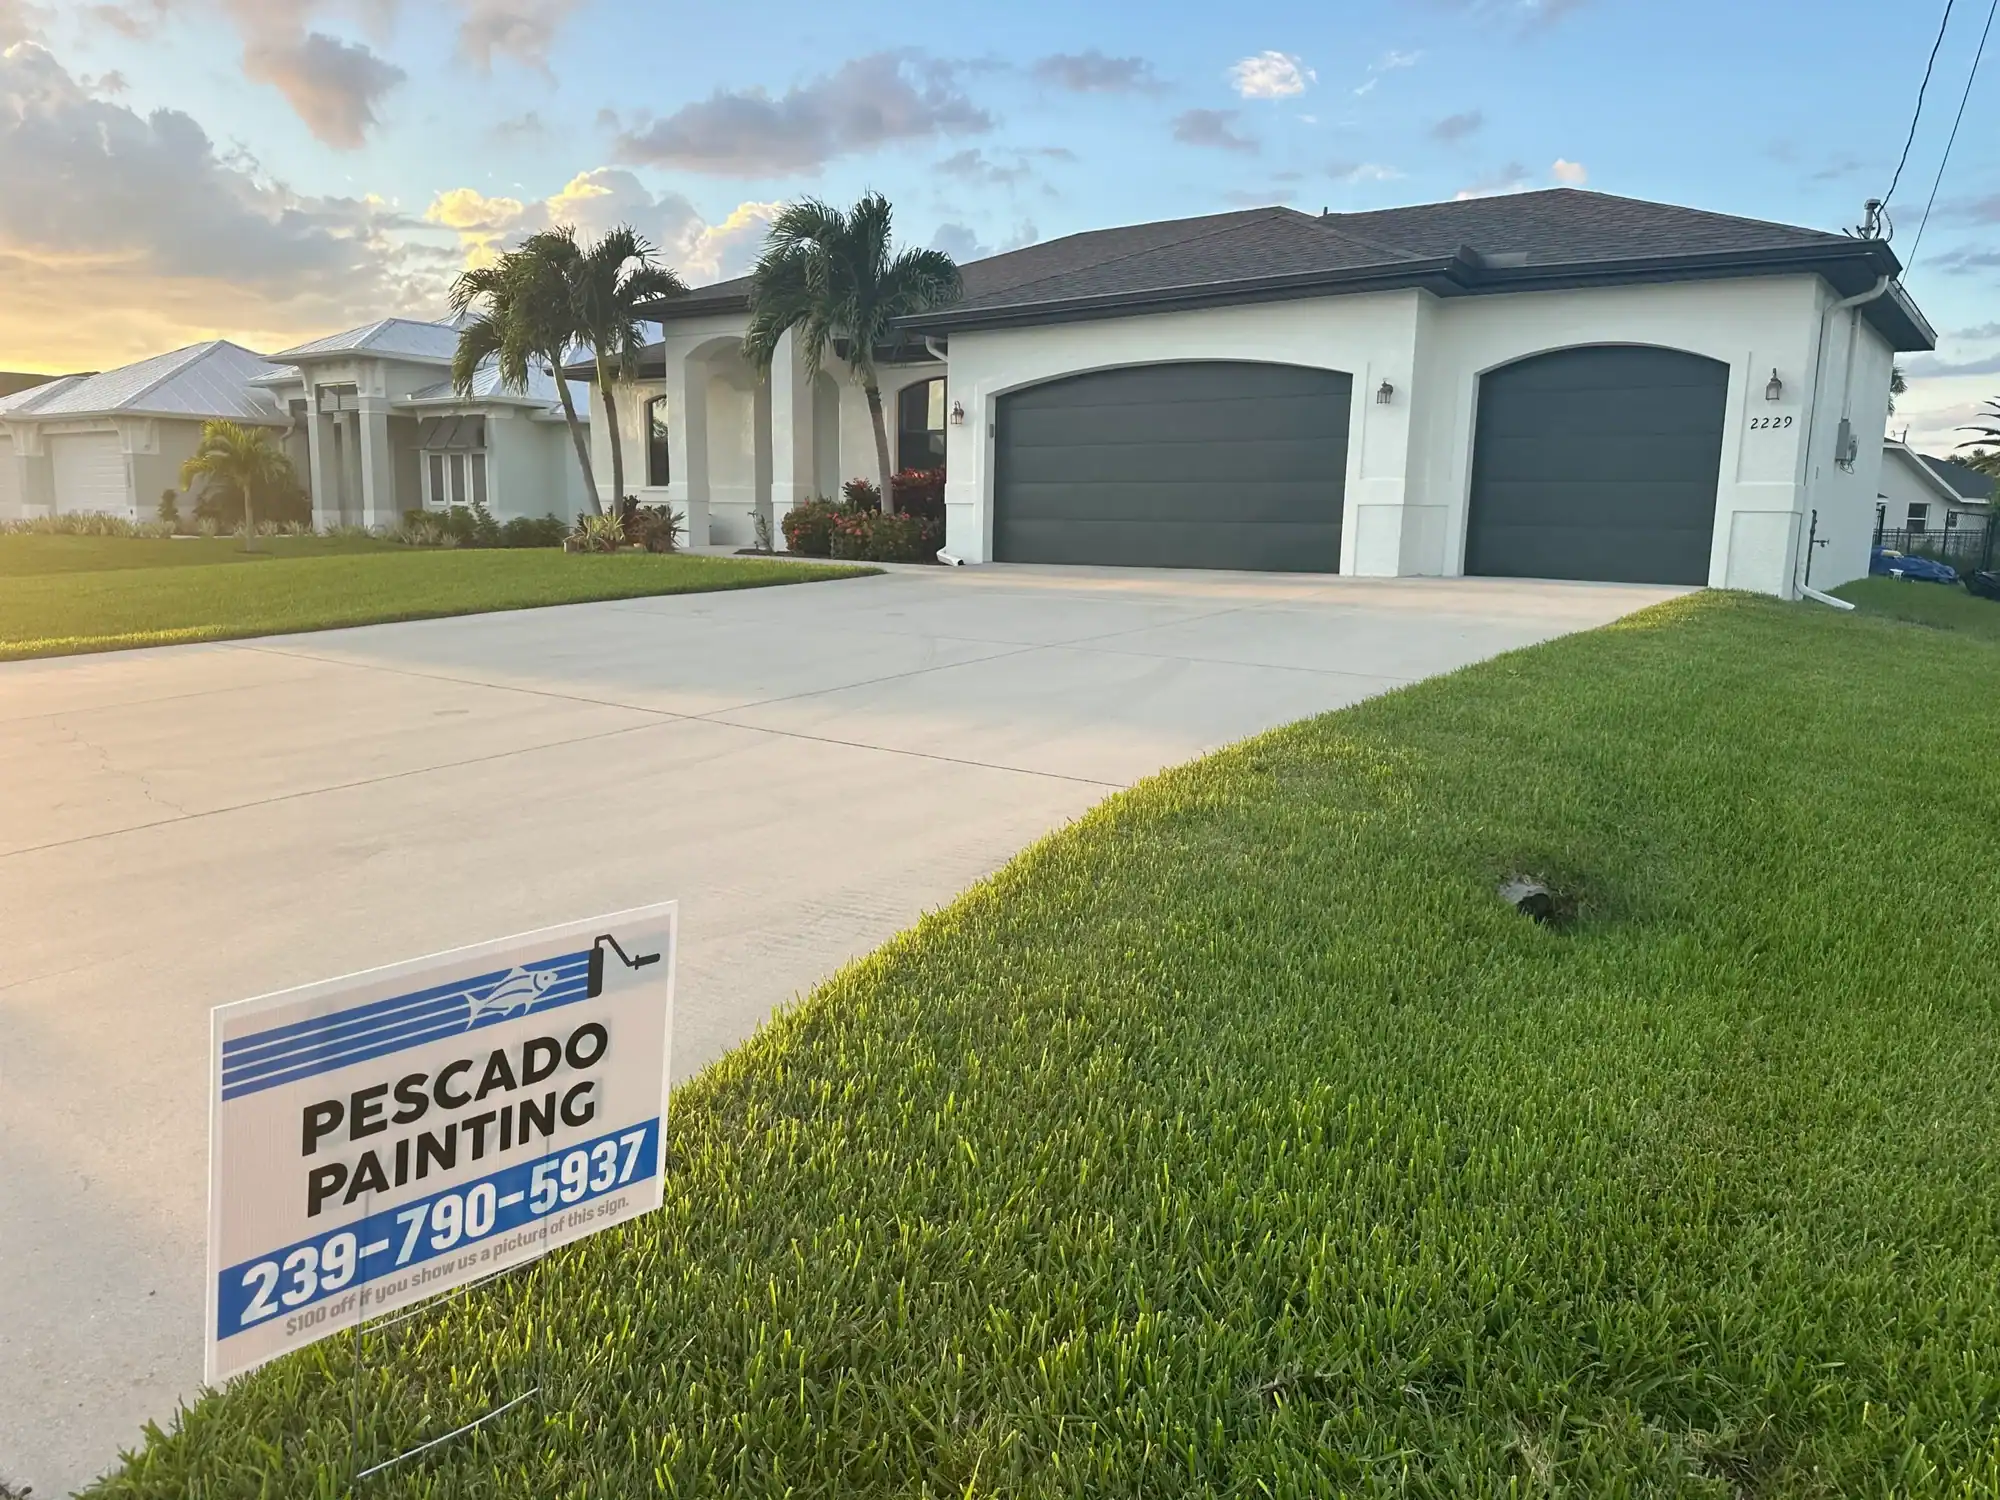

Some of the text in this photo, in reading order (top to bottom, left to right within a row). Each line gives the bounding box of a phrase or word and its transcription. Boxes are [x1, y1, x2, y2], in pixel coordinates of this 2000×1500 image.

[1750, 415, 1793, 430] 2229
[302, 1022, 608, 1157] PESCADO
[307, 1081, 596, 1218] PAINTING
[240, 1129, 647, 1326] 239-790-5937
[286, 1196, 629, 1336] $100 off if you show us a picture of this sign.
